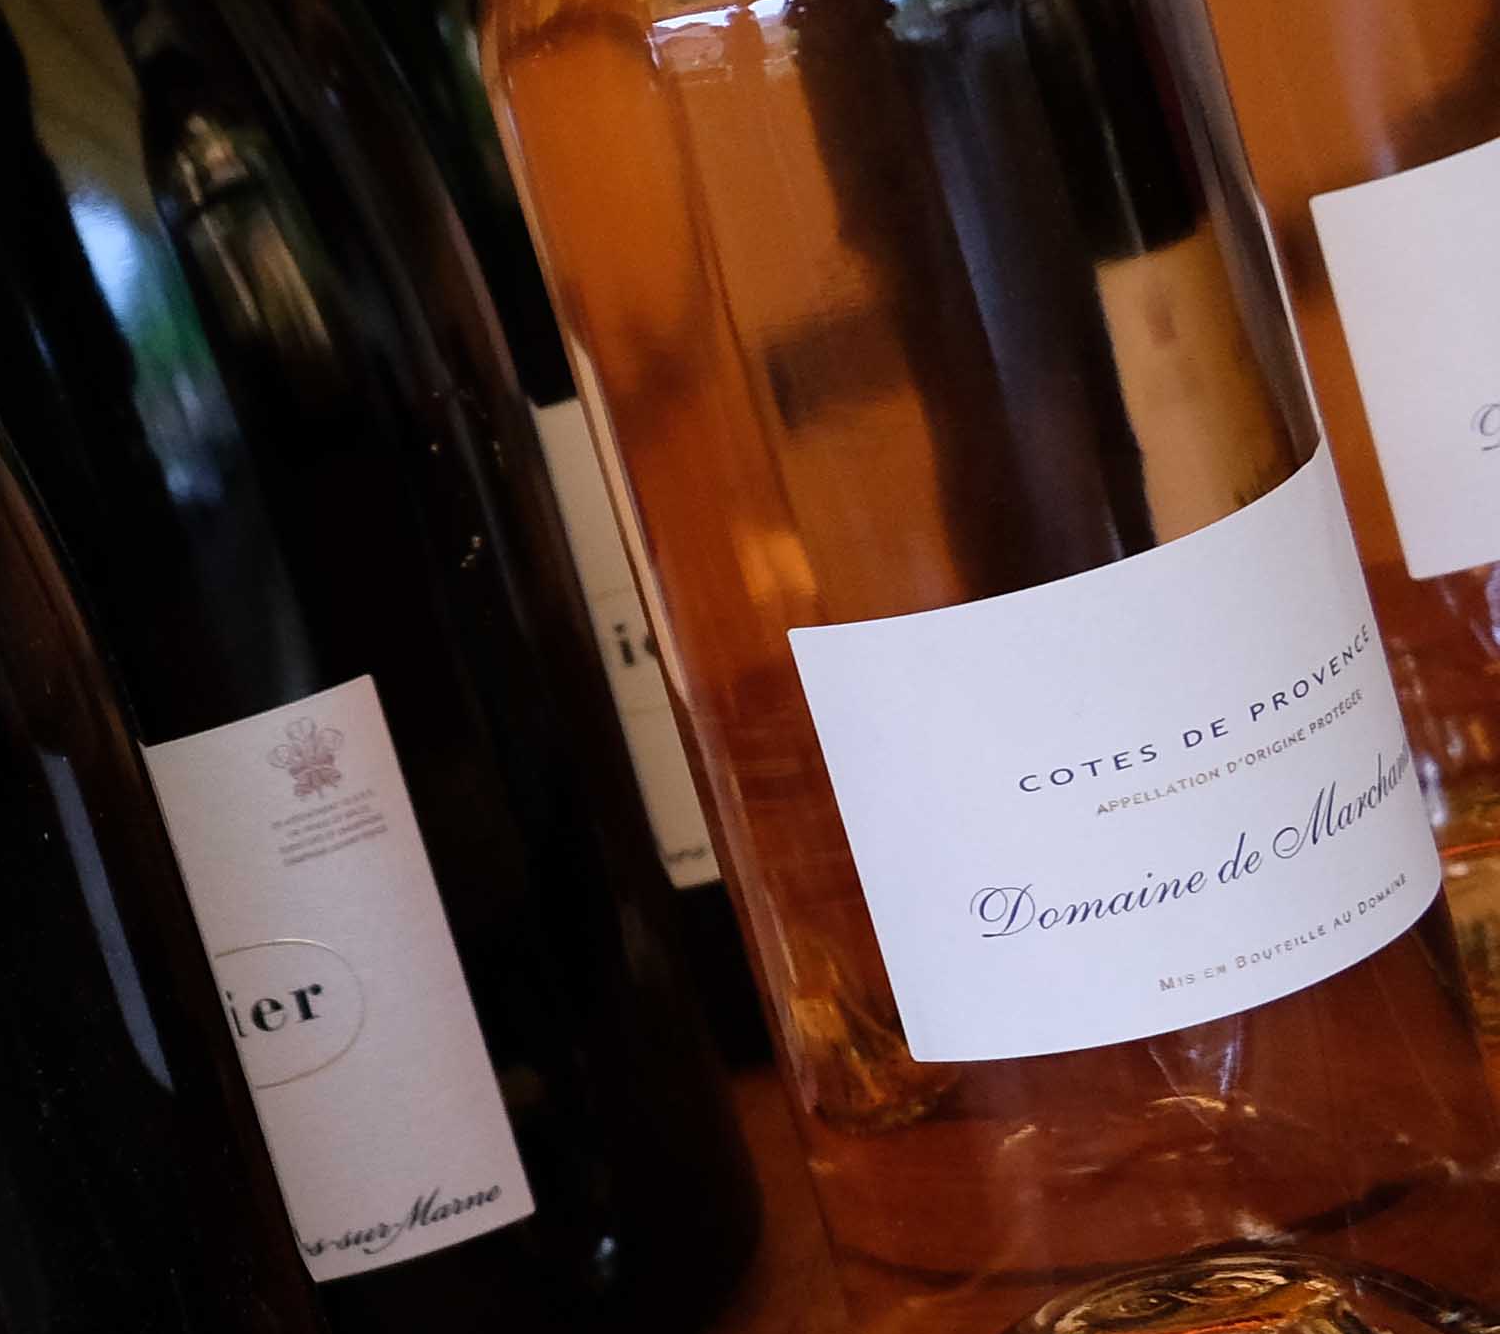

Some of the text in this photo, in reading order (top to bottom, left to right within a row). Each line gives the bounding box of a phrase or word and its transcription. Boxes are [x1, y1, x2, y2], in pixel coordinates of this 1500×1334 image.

[1019, 623, 1371, 794] COTES DE PROVENCE
[1096, 767, 1221, 816] APPELLATION
[968, 872, 1208, 940] Domaine
[1217, 832, 1263, 885] de
